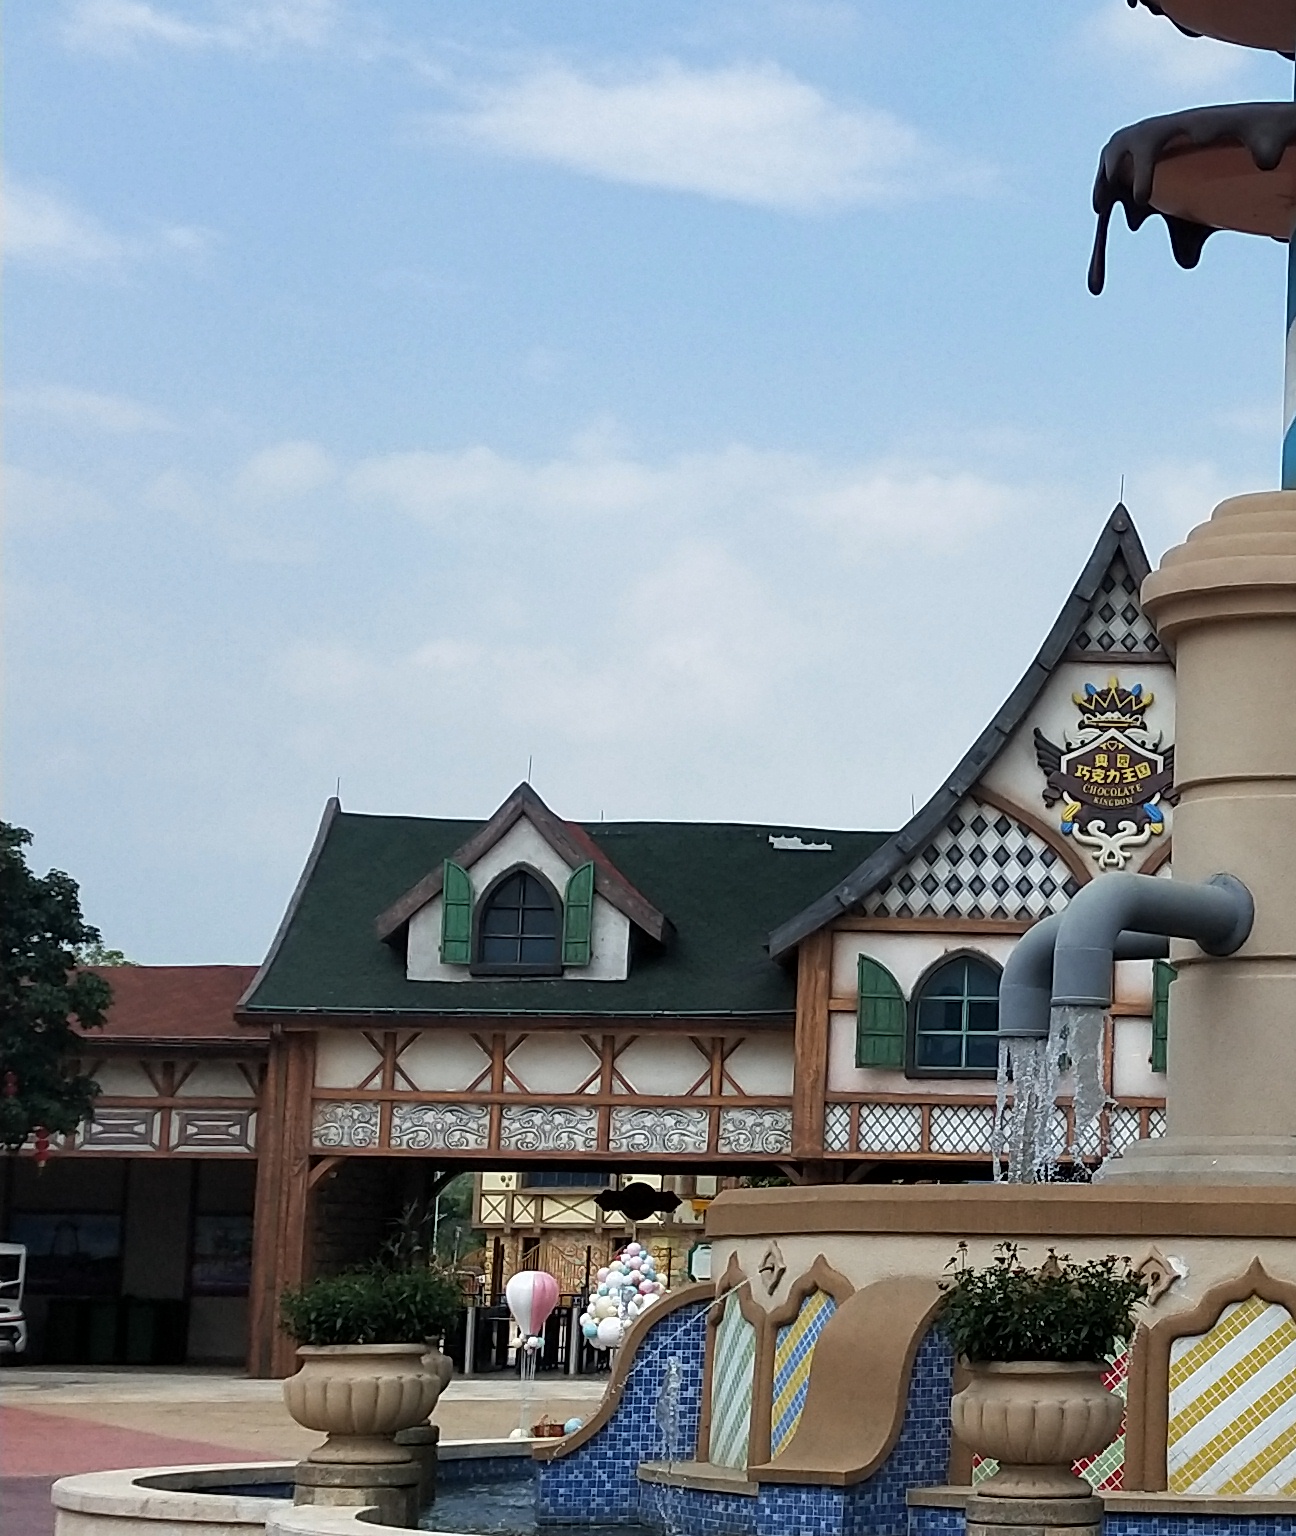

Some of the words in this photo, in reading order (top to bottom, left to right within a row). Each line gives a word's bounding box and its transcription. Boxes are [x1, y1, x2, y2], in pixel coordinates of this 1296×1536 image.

[1075, 762, 1151, 783] 巧克力王国
[1083, 784, 1143, 797] CHOCOLATE
[1093, 797, 1133, 807] KINGDOM
